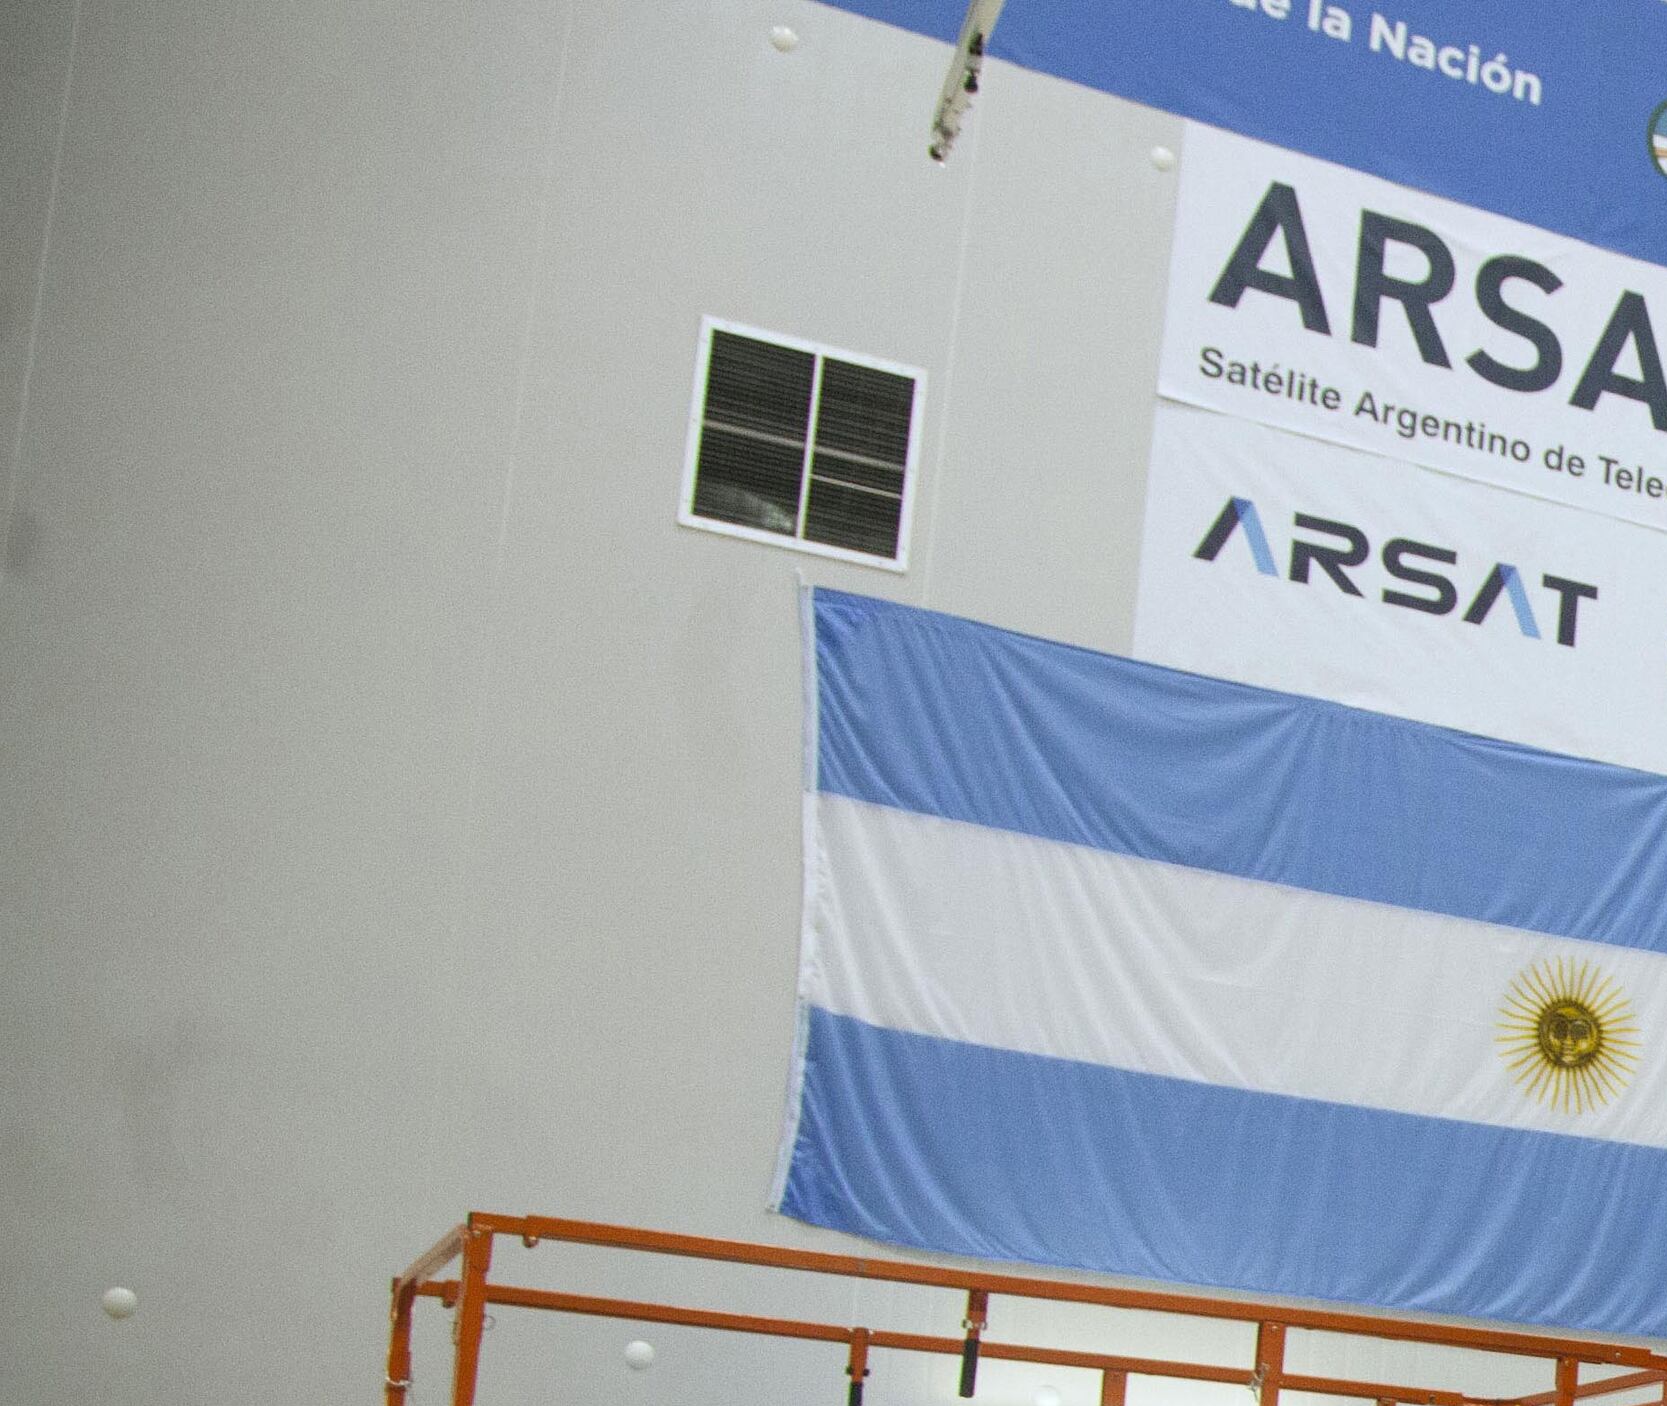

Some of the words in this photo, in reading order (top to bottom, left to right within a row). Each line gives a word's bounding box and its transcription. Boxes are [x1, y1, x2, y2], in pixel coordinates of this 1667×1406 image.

[1307, 0, 1351, 41] la
[1368, 13, 1542, 105] Nación
[1200, 346, 1342, 412] Satélite
[1355, 391, 1532, 463] Argentino
[1544, 444, 1586, 477] de
[1193, 496, 1599, 648] ARSAT
